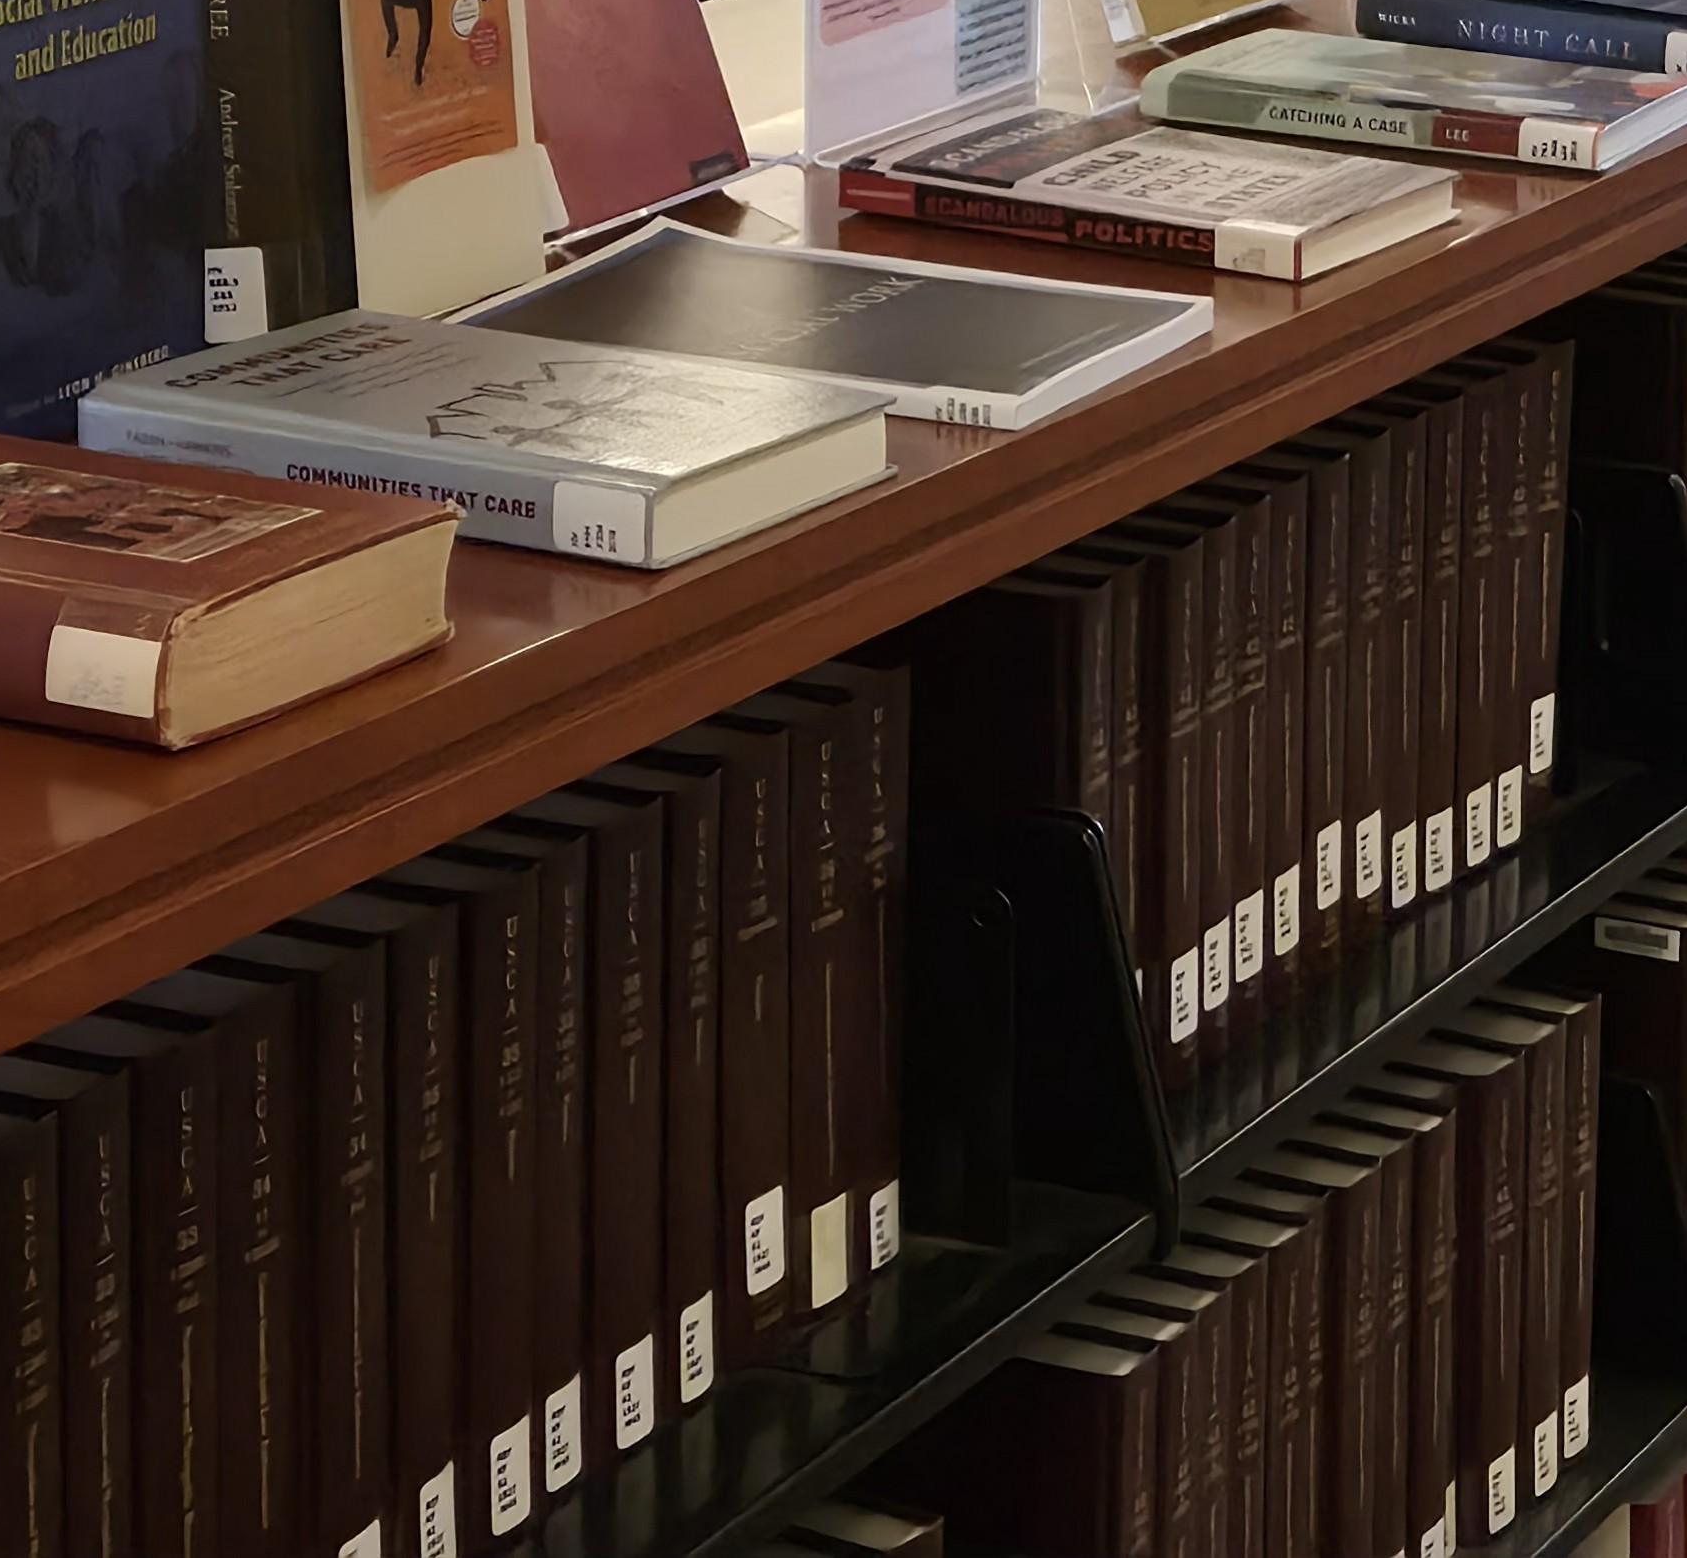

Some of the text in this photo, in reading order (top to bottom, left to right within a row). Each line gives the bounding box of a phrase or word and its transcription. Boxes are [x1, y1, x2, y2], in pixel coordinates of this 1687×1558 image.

[15, 12, 157, 81] and Education
[1458, 19, 1637, 61] NIGHT CALL
[218, 88, 236, 162] Andrew
[1268, 105, 1409, 136] CATCHING A CASE
[1446, 127, 1470, 142] LEE
[1043, 150, 1141, 186] CHILD
[1123, 160, 1222, 199] POLICY
[924, 192, 1215, 253] SCANDALOUS POLITICS
[229, 360, 323, 386] THAT
[286, 462, 537, 520] COMMUNITIES THAT CARE
